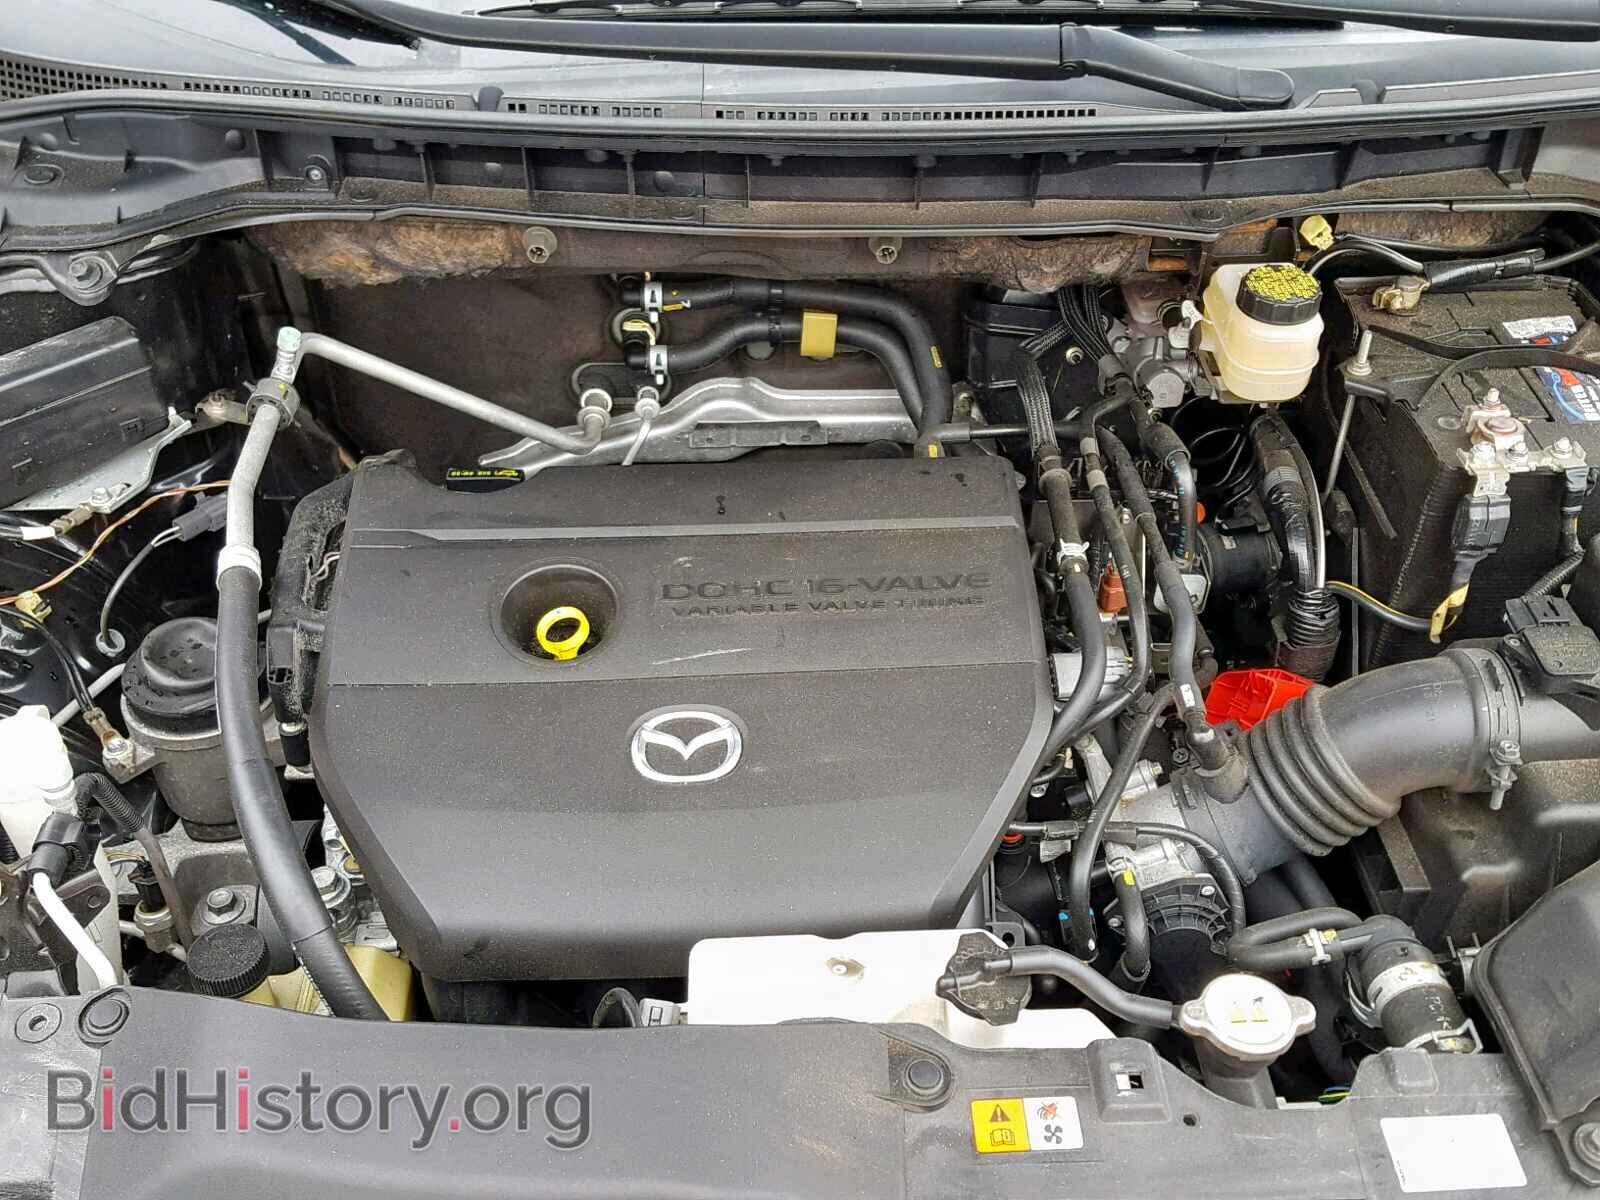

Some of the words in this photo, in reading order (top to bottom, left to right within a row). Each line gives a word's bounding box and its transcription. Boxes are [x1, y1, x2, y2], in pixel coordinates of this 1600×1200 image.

[662, 580, 794, 600] DOHC
[806, 573, 993, 594] 16-VALVE
[672, 603, 800, 616] VARIABLE
[808, 600, 887, 611] VALVE
